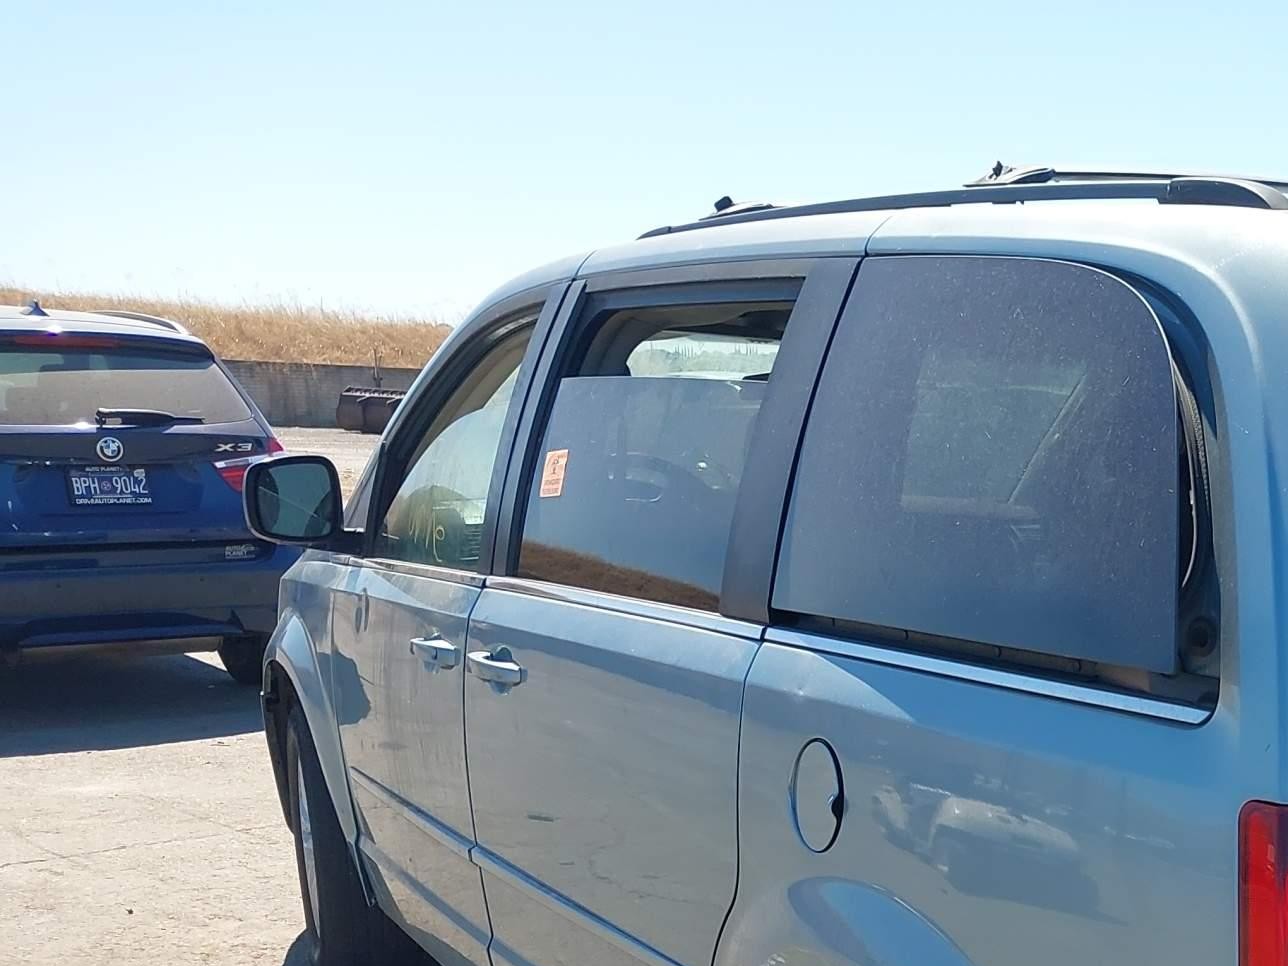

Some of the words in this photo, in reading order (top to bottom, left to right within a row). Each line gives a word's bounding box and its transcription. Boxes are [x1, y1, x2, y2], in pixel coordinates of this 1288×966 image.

[214, 443, 253, 452] X3
[71, 477, 101, 496] BPH
[112, 476, 149, 494] 9042
